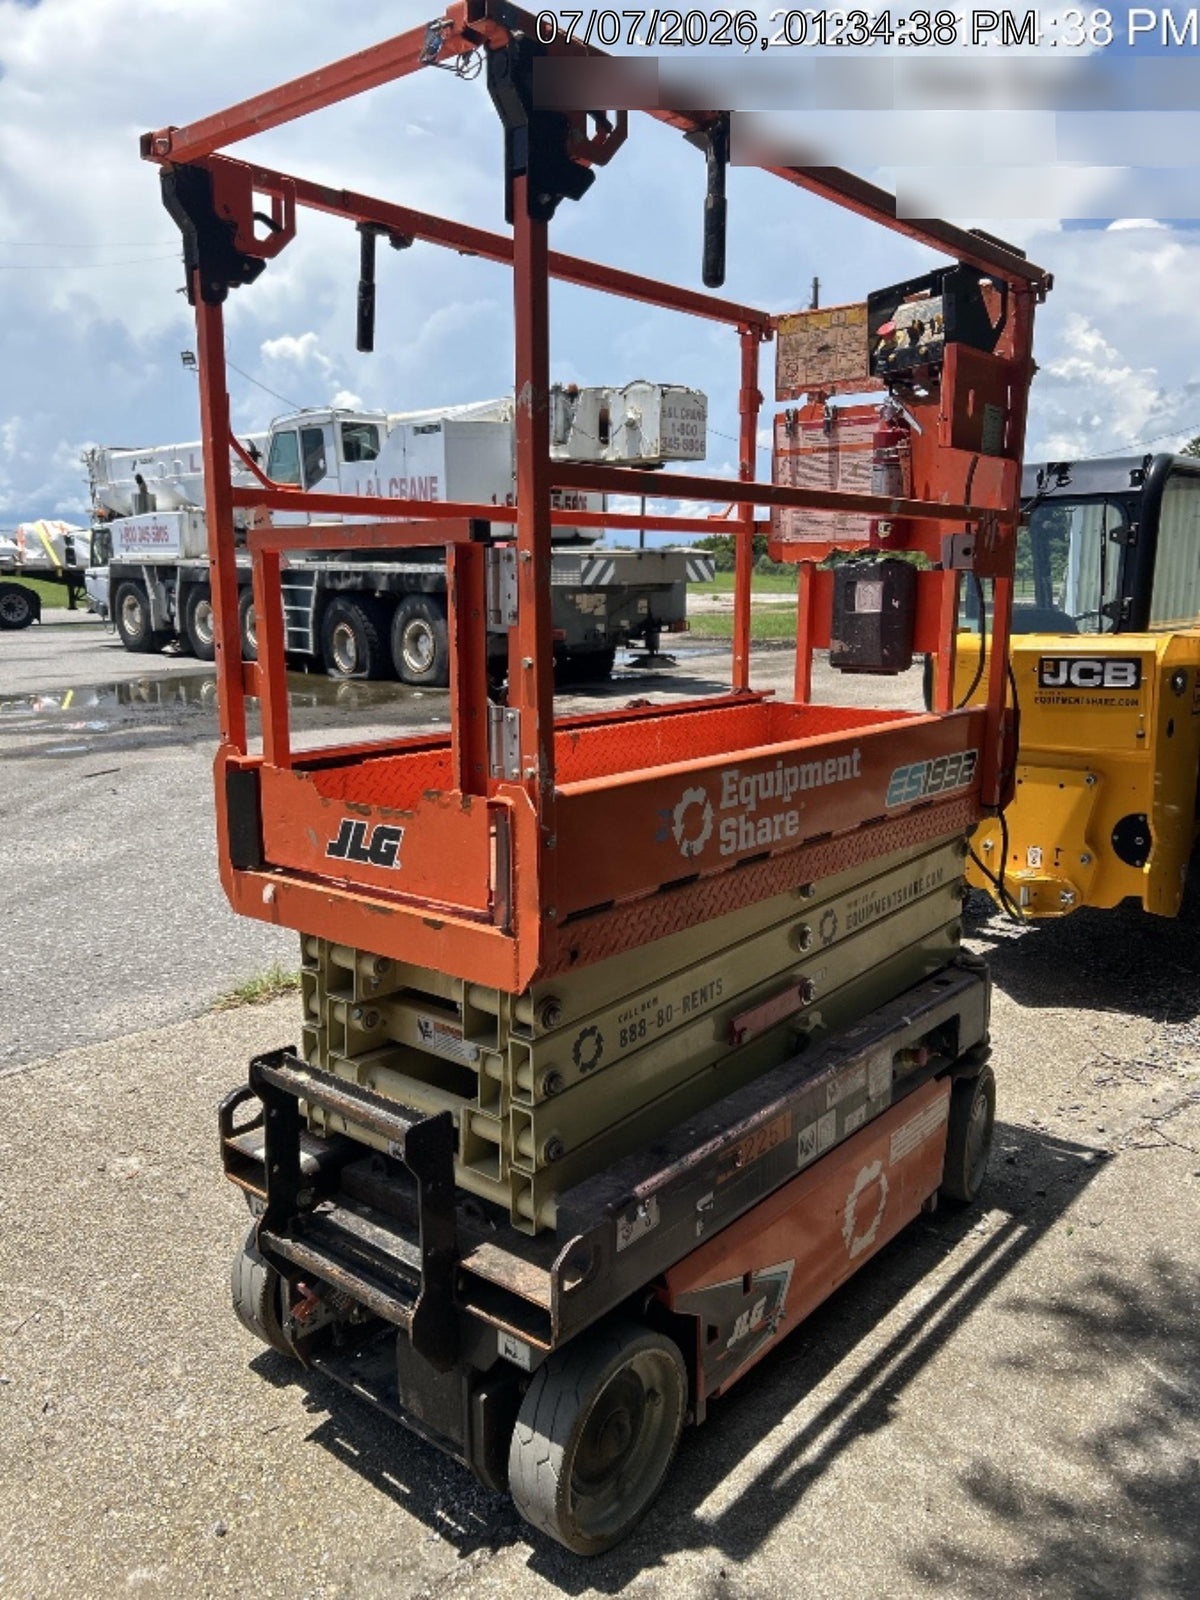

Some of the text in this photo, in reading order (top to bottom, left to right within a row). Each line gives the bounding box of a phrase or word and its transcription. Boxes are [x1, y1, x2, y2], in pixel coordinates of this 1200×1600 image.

[388, 476, 439, 501] CRANE
[1042, 660, 1137, 688] JCB
[719, 748, 862, 811] Equipment
[884, 749, 979, 808] ES1932
[326, 818, 405, 869] JLG
[719, 808, 800, 856] Share
[619, 977, 723, 1048] 888-80-RENTS
